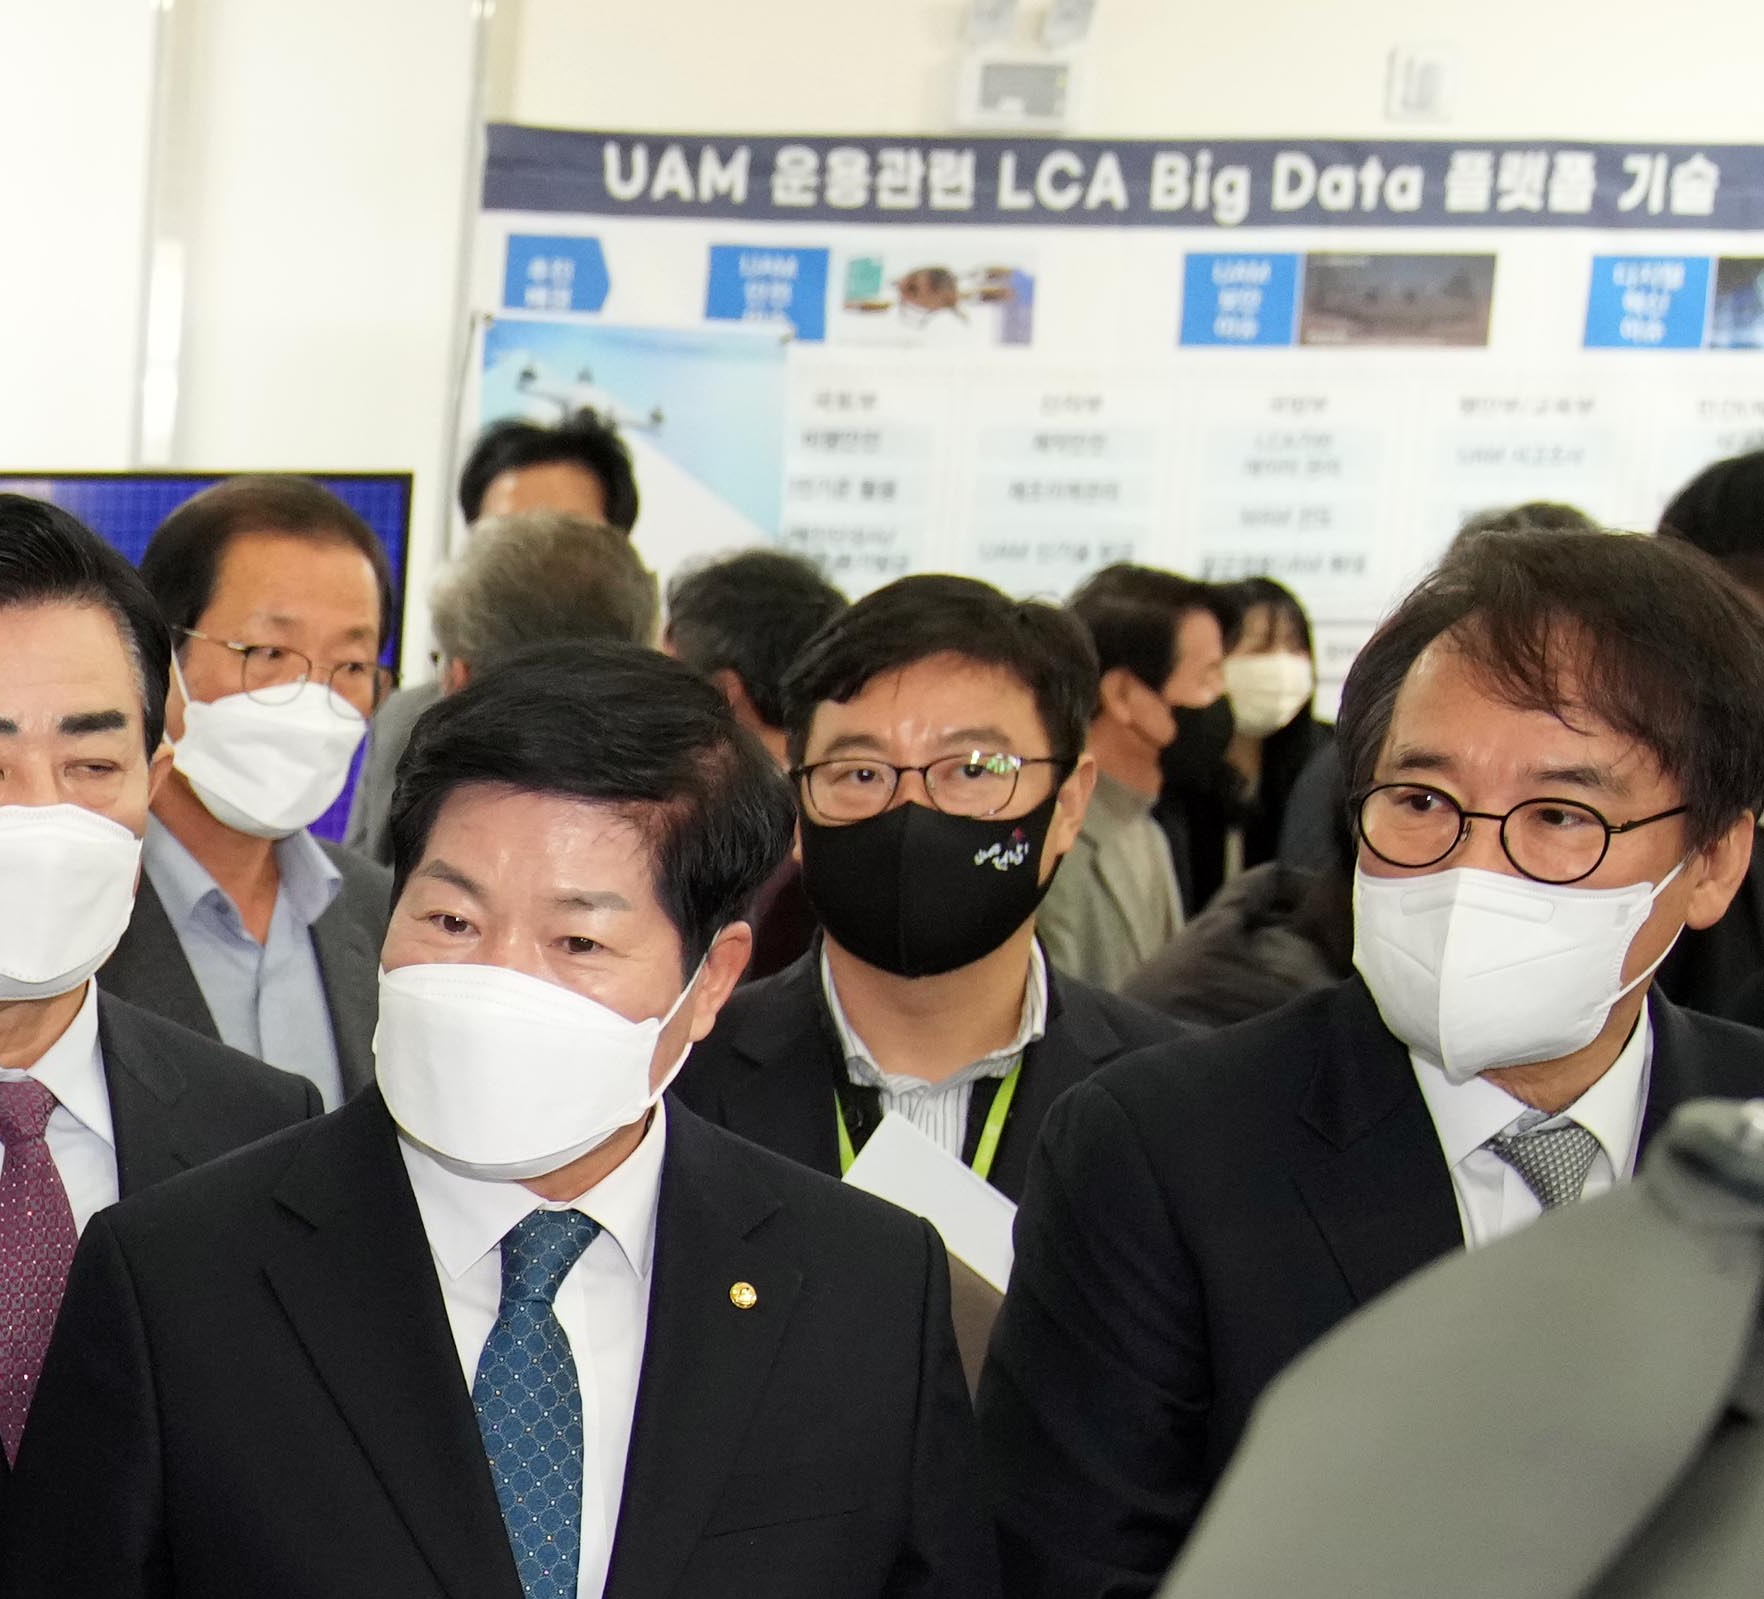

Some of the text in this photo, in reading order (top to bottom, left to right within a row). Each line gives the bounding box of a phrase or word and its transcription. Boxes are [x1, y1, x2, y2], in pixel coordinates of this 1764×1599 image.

[603, 139, 1720, 226] UAM 운용관련 LCA Big Data 플랫폼 기술
